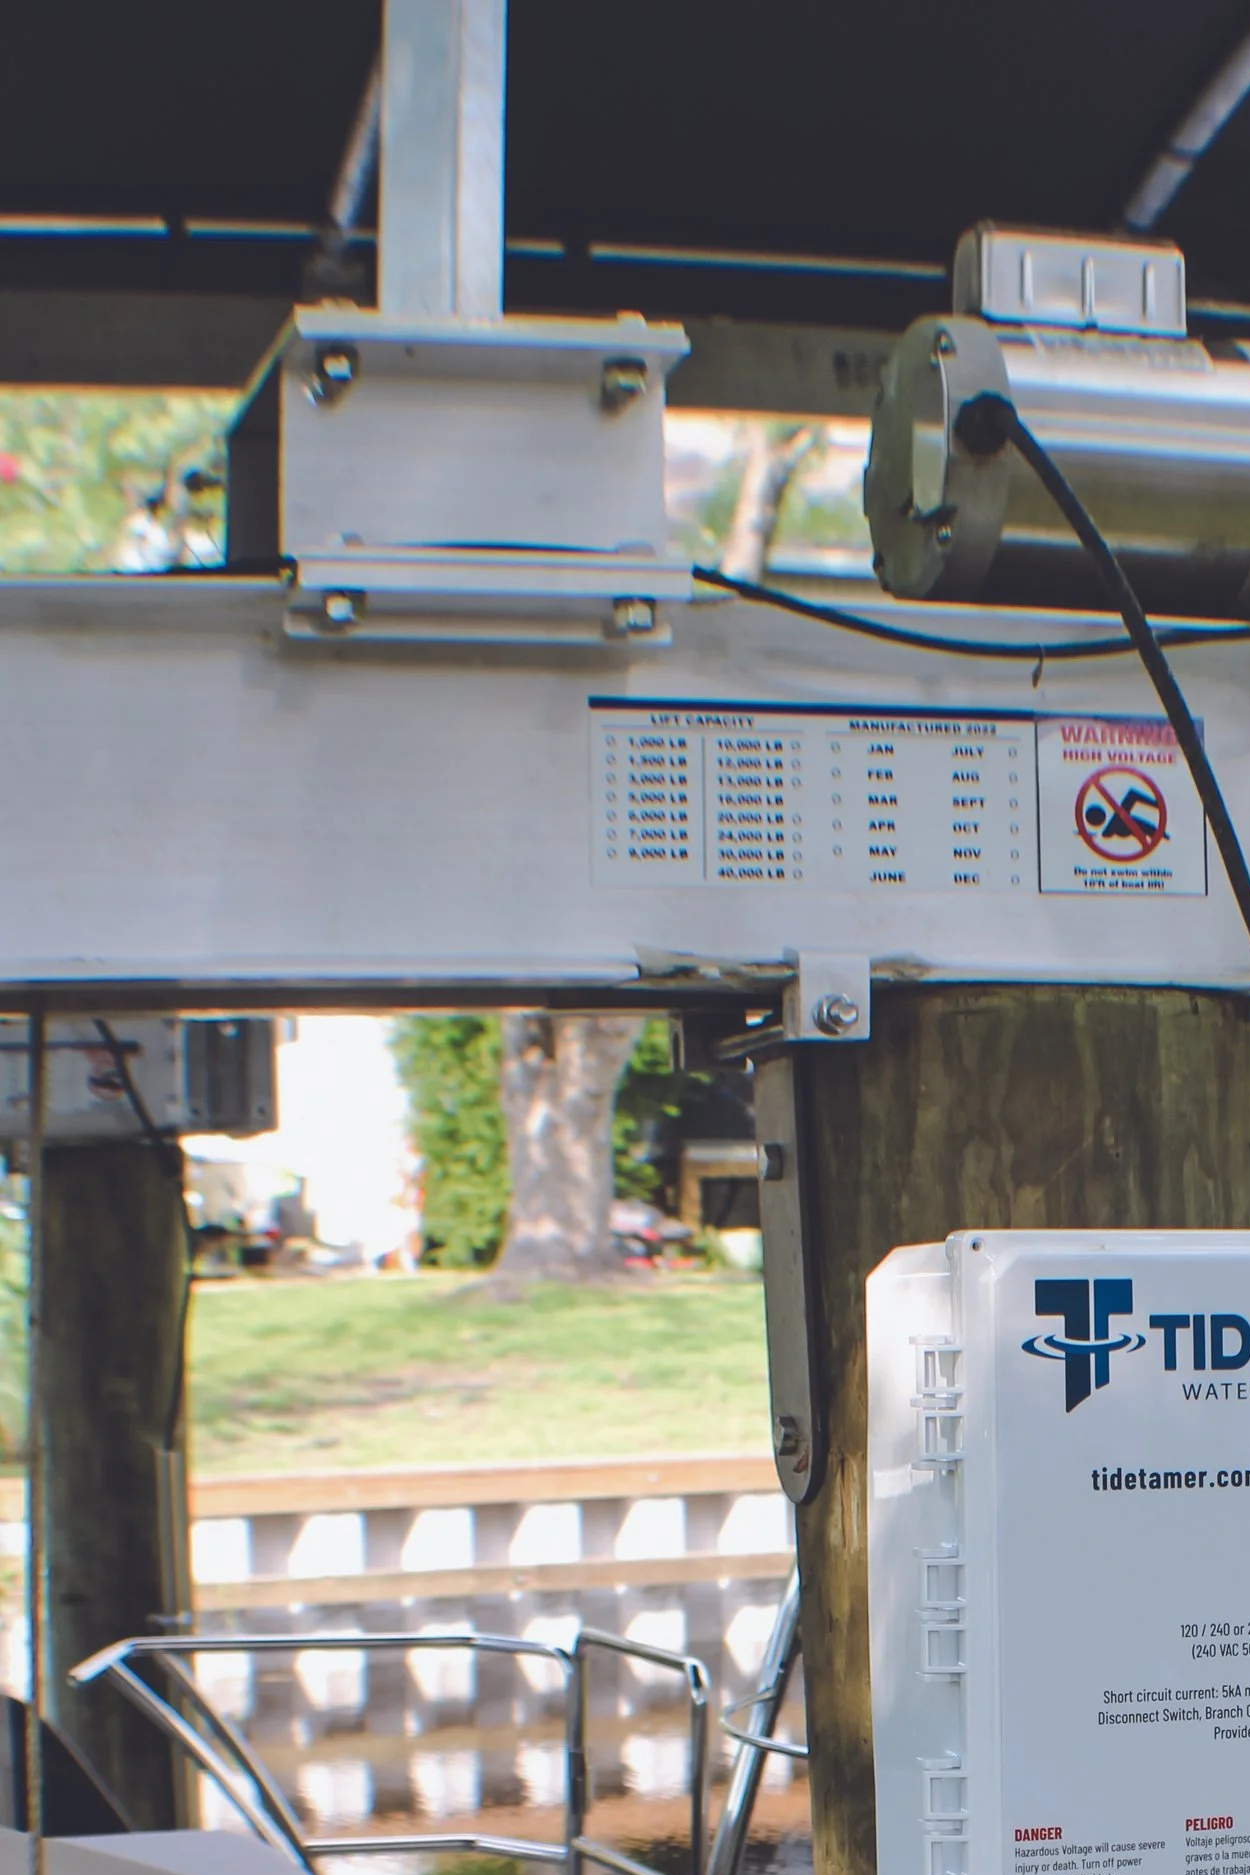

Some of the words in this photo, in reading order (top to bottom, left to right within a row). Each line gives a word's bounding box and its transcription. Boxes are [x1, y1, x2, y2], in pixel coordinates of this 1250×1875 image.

[650, 713, 680, 727] LIFT
[686, 714, 756, 729] CAPACITY
[849, 719, 962, 735] MANUFACTURED
[1060, 723, 1180, 747] WARNING
[867, 743, 895, 756] JAN
[952, 744, 985, 758] JULY
[1063, 748, 1102, 763] HIGH
[1107, 750, 1177, 765] VOLTAGE
[867, 767, 894, 781] FEB
[952, 770, 980, 783] AUG
[867, 793, 898, 807] MAR
[952, 795, 986, 809] SEPT
[869, 819, 896, 833] APR
[953, 820, 979, 834] OCT
[869, 845, 897, 858] MAY
[953, 846, 981, 859] NOV
[870, 870, 906, 883] JUNE
[954, 871, 980, 885] DEC
[1180, 1623, 1198, 1638] 120
[1209, 1622, 1230, 1637] 240
[1232, 1625, 1245, 1636] or
[1190, 1643, 1216, 1660] (240
[1218, 1642, 1239, 1656] VAC
[1102, 1690, 1133, 1704] Short
[1136, 1687, 1172, 1702] circuit
[1174, 1686, 1219, 1700] current:
[1221, 1684, 1242, 1698] 5kA
[1097, 1710, 1160, 1725] Disconnect
[1162, 1706, 1202, 1722] Switch,
[1204, 1704, 1243, 1720] Branch
[1184, 1816, 1234, 1832] PELIGRO
[1014, 1826, 1062, 1842] DANGER
[1184, 1835, 1213, 1848] Voltaje
[1014, 1846, 1060, 1858] Hazardous
[1060, 1844, 1093, 1856] Voltage
[1094, 1842, 1109, 1853] will
[1110, 1842, 1136, 1852] cause
[1137, 1840, 1166, 1850] severe
[1184, 1853, 1213, 1864] graves
[1214, 1852, 1220, 1861] o
[1221, 1850, 1230, 1860] la
[1014, 1862, 1040, 1875] injury
[1040, 1863, 1050, 1872] or
[1052, 1859, 1079, 1871] death.
[1080, 1858, 1101, 1870] Turn
[1101, 1857, 1114, 1868] off
[1116, 1857, 1142, 1869] power
[1209, 1865, 1221, 1875] de
